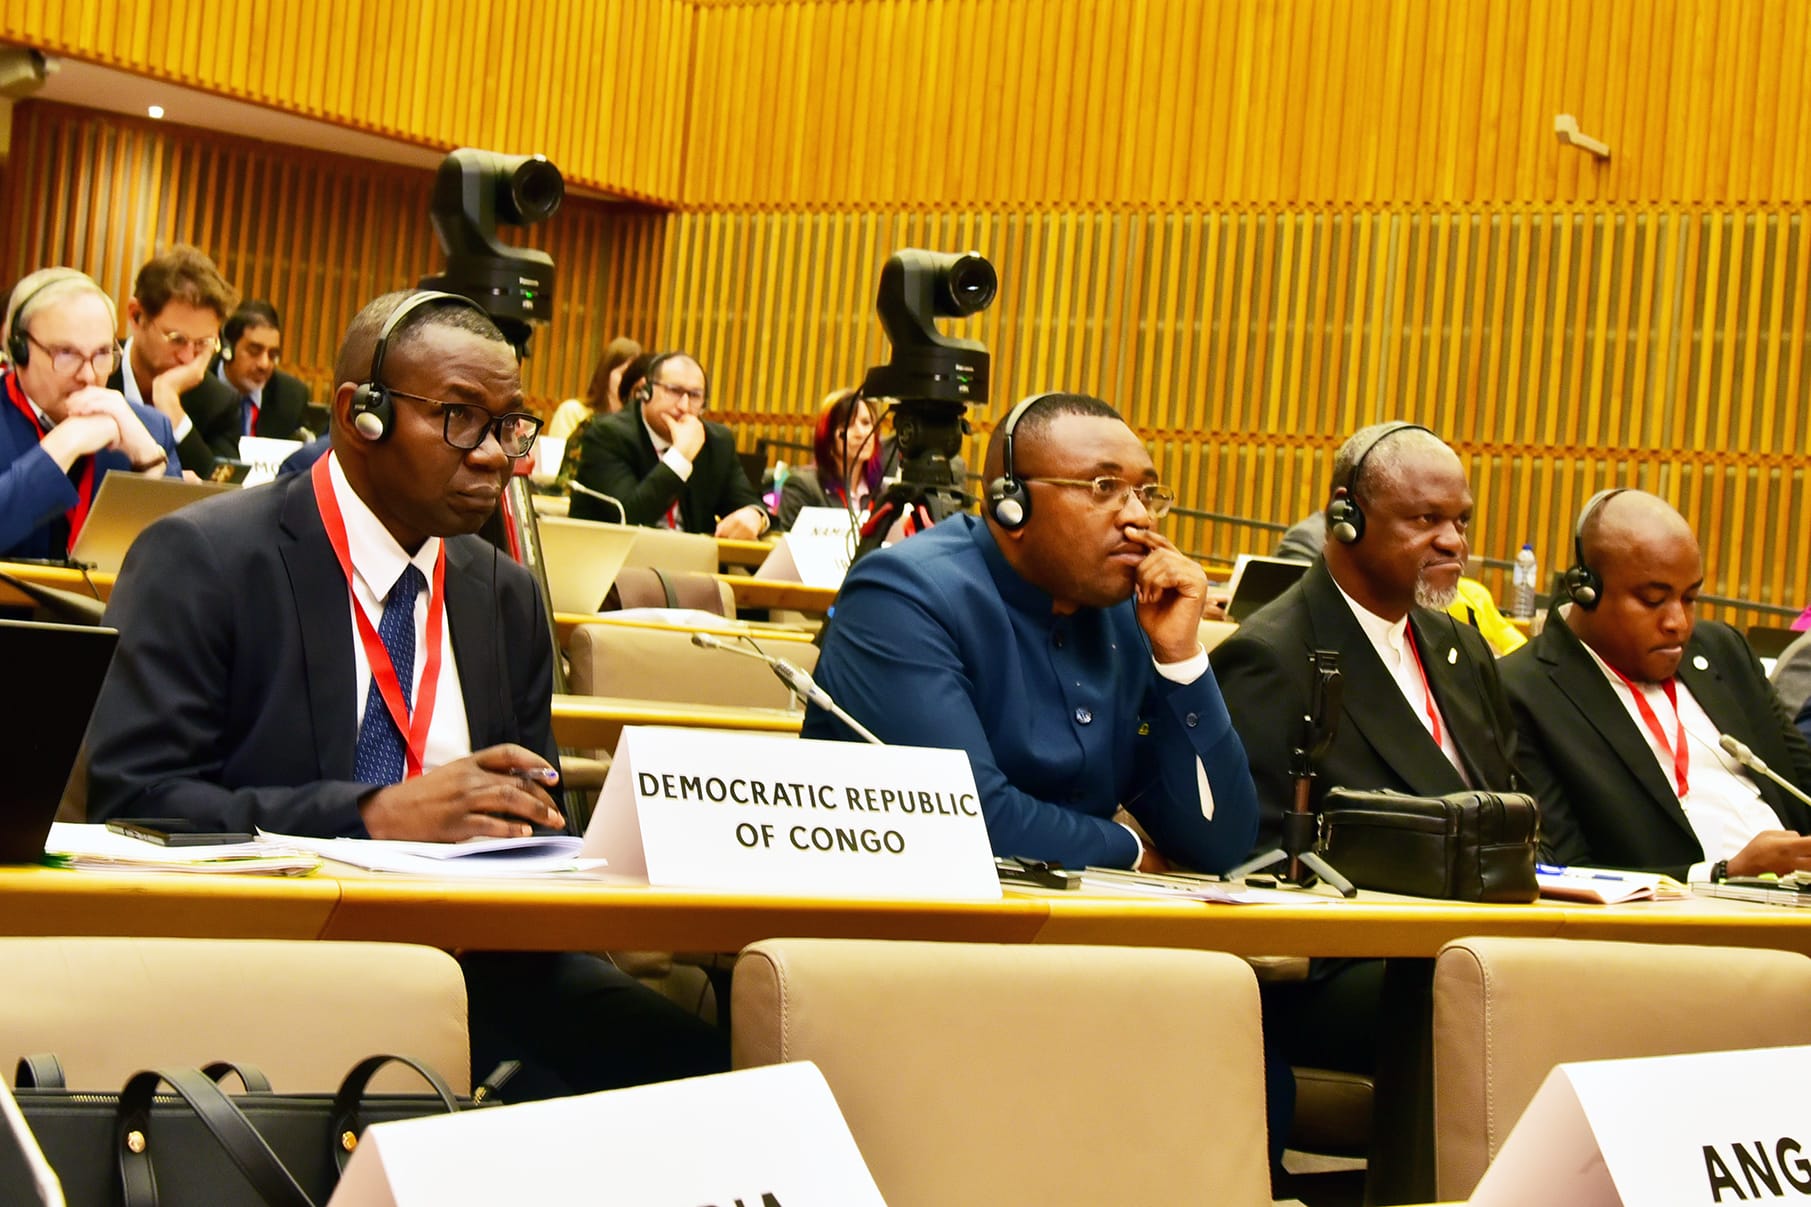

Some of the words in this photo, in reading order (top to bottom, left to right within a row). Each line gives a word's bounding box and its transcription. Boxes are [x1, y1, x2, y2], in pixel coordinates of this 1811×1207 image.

[638, 772, 837, 810] DEMOCRATIC
[845, 787, 979, 817] REPUBLIC
[735, 822, 775, 848] OF
[789, 825, 906, 854] CONGO
[1702, 1137, 1811, 1204] ANG
